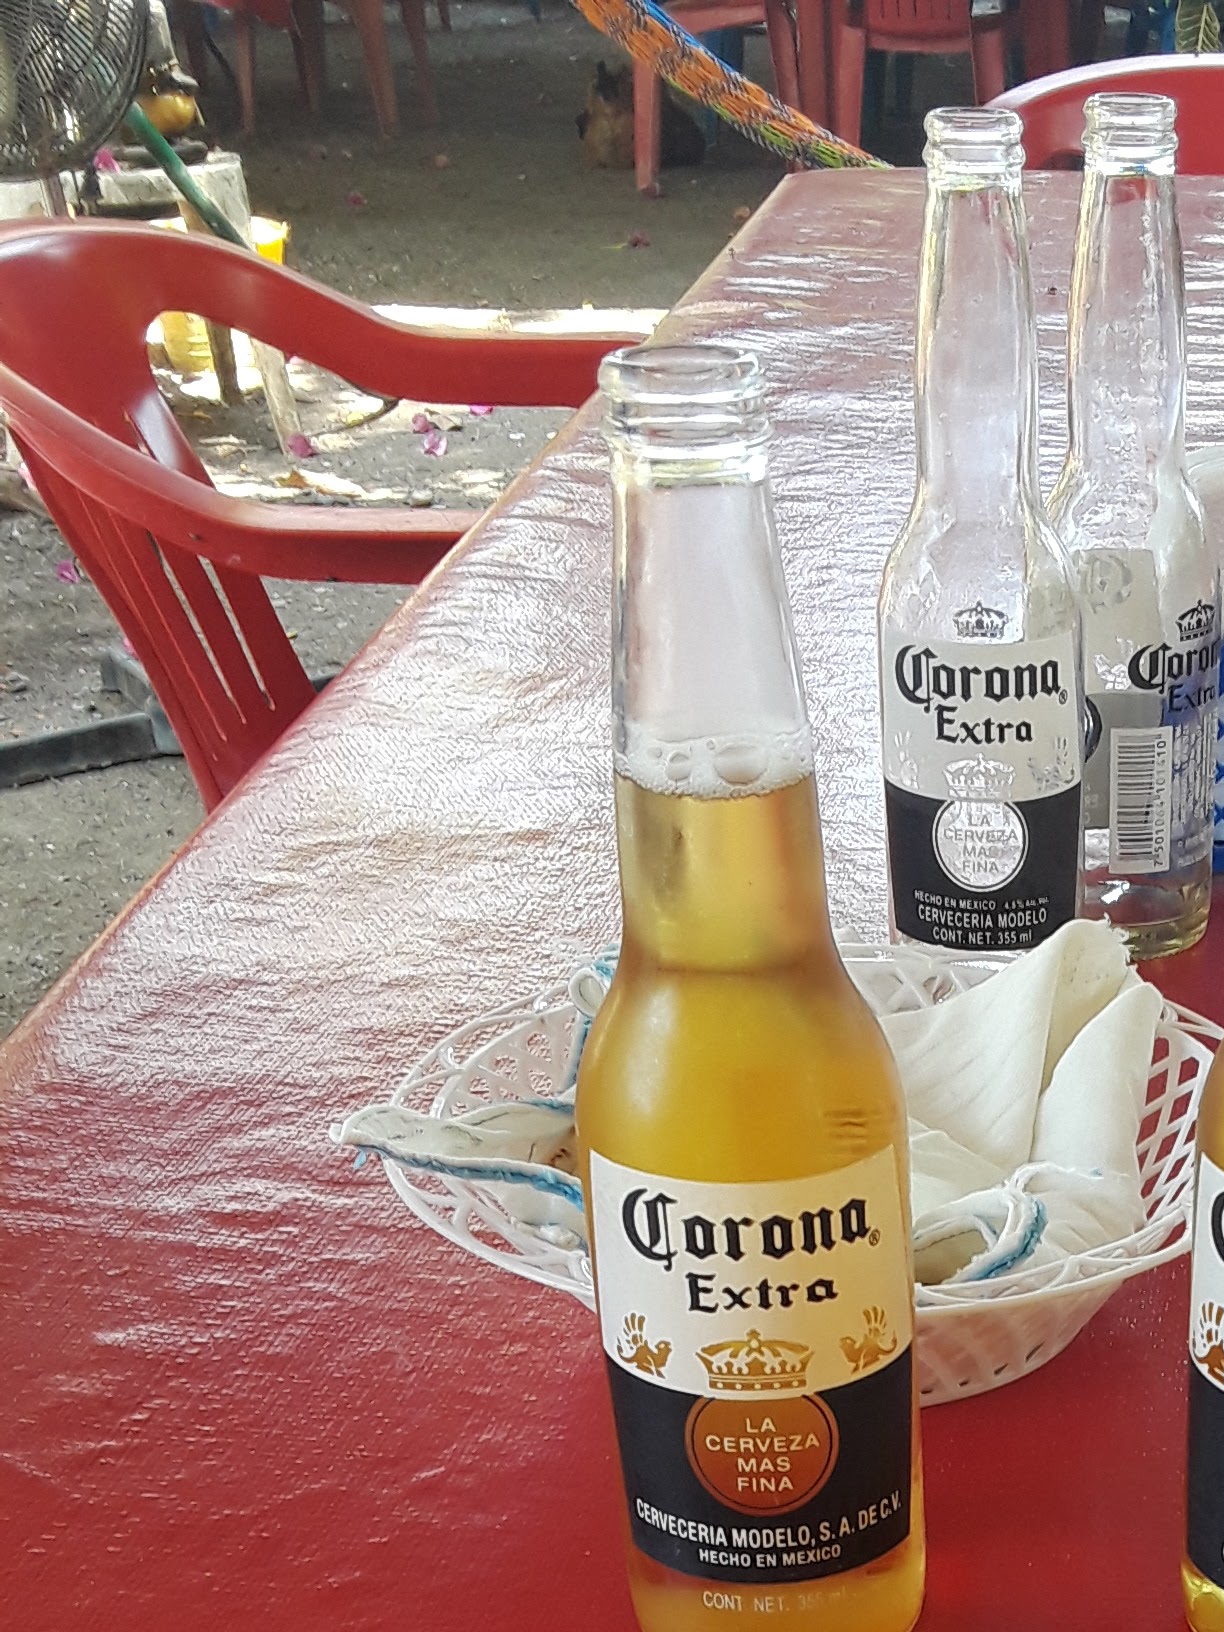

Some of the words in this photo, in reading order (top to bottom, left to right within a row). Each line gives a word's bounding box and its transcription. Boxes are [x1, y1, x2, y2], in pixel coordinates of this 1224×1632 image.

[895, 645, 1062, 714] Corona
[934, 704, 1033, 745] Extra
[968, 814, 991, 827] LA
[962, 860, 999, 873] FINA
[914, 889, 943, 906] HECHO
[944, 897, 957, 908] EN
[959, 899, 996, 911] MEXICO
[918, 904, 994, 930] CERVECERIA
[998, 908, 1047, 929] MODELO
[932, 926, 965, 944] CONT.
[968, 931, 994, 945] NET.
[997, 931, 1017, 944] 355
[1019, 928, 1033, 943] ml
[621, 1188, 872, 1272] Corona
[684, 1271, 839, 1314] Extra
[745, 1417, 777, 1433] LA
[705, 1432, 820, 1453] CERVEZA
[737, 1456, 792, 1473] MAS
[737, 1475, 794, 1493] FINA
[635, 1497, 728, 1548] CERVECERIA
[732, 1524, 816, 1549] MODELO,
[857, 1506, 878, 1529] DE
[879, 1490, 902, 1519] C.V.
[698, 1547, 751, 1568] HECHO
[756, 1552, 777, 1568] EN
[782, 1543, 842, 1566] MEXICO
[753, 1596, 791, 1613] NET.
